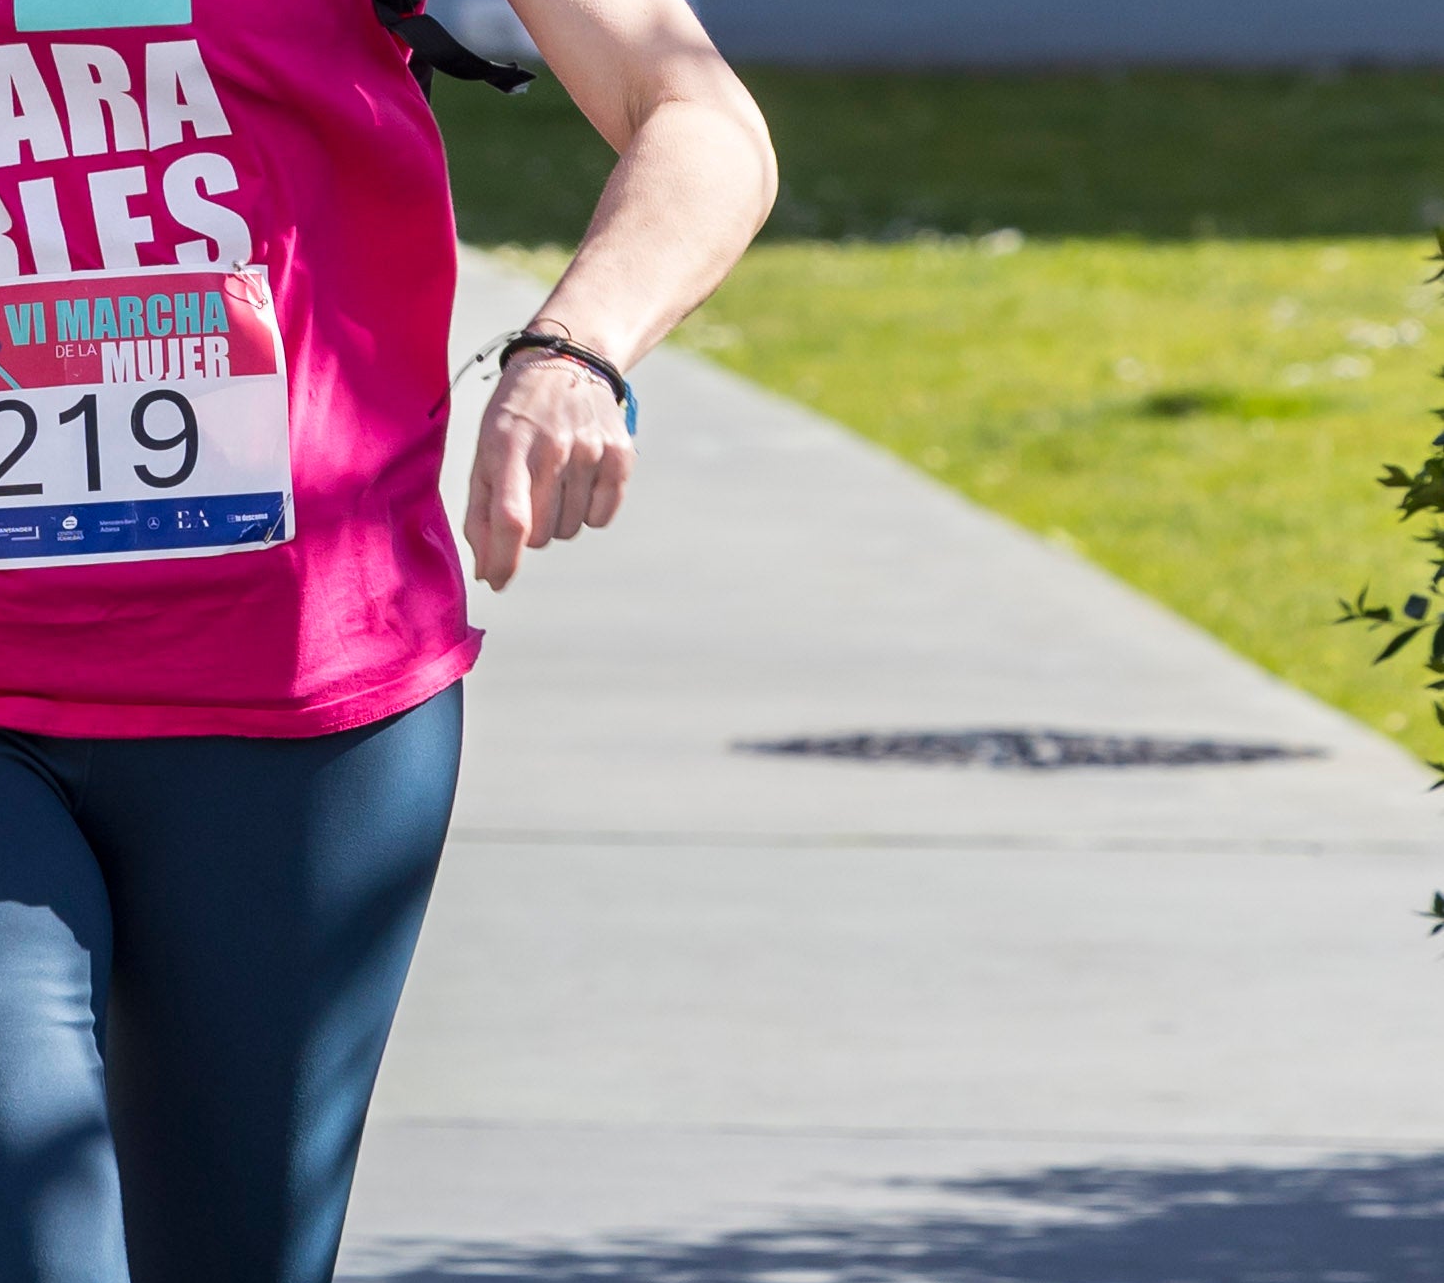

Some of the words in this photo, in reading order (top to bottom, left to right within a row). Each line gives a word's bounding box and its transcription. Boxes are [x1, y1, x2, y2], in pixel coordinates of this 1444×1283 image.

[4, 302, 47, 347] VI
[55, 291, 230, 342] MARCHA
[55, 343, 78, 360] DE
[79, 341, 98, 357] LA
[101, 335, 231, 385] MUJER
